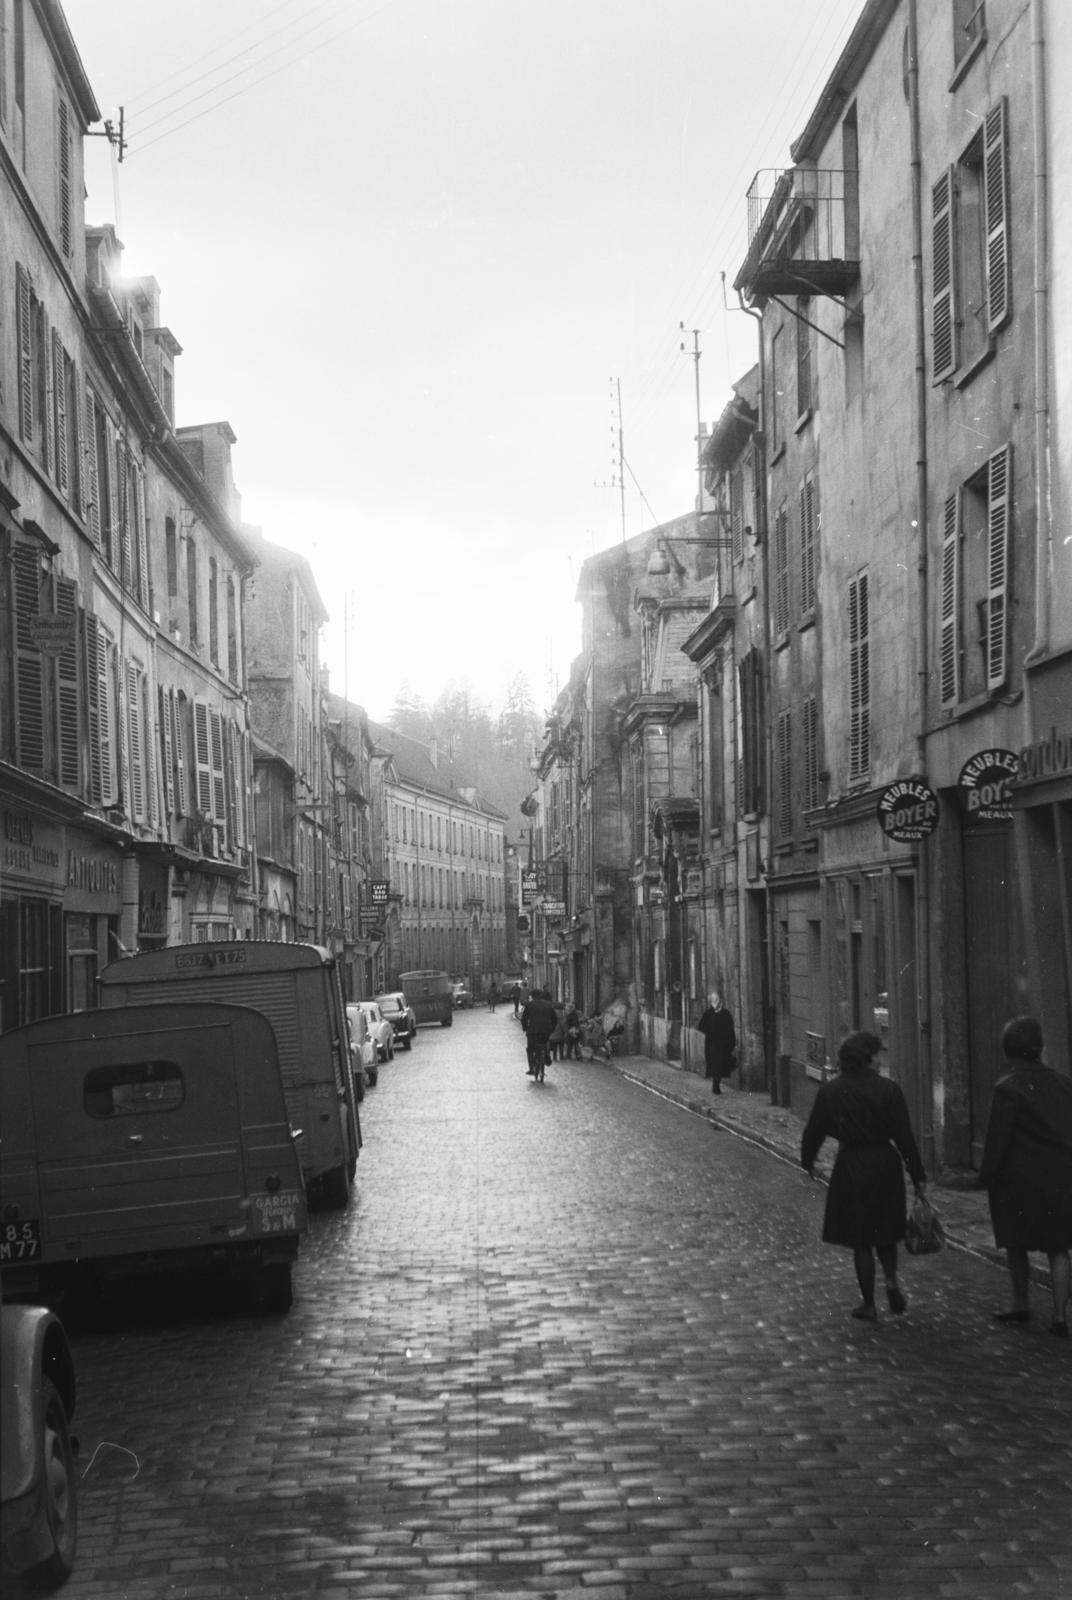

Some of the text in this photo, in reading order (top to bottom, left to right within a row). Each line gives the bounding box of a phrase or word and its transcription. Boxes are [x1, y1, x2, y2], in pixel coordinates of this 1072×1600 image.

[961, 752, 1019, 787] MEUBLES
[880, 782, 931, 811] MEUBLES
[885, 801, 936, 831] BOYER
[978, 810, 1014, 819] MEAUX
[892, 831, 922, 839] MEAUX
[255, 1193, 300, 1208] GARCIA
[6, 1222, 33, 1241] 85
